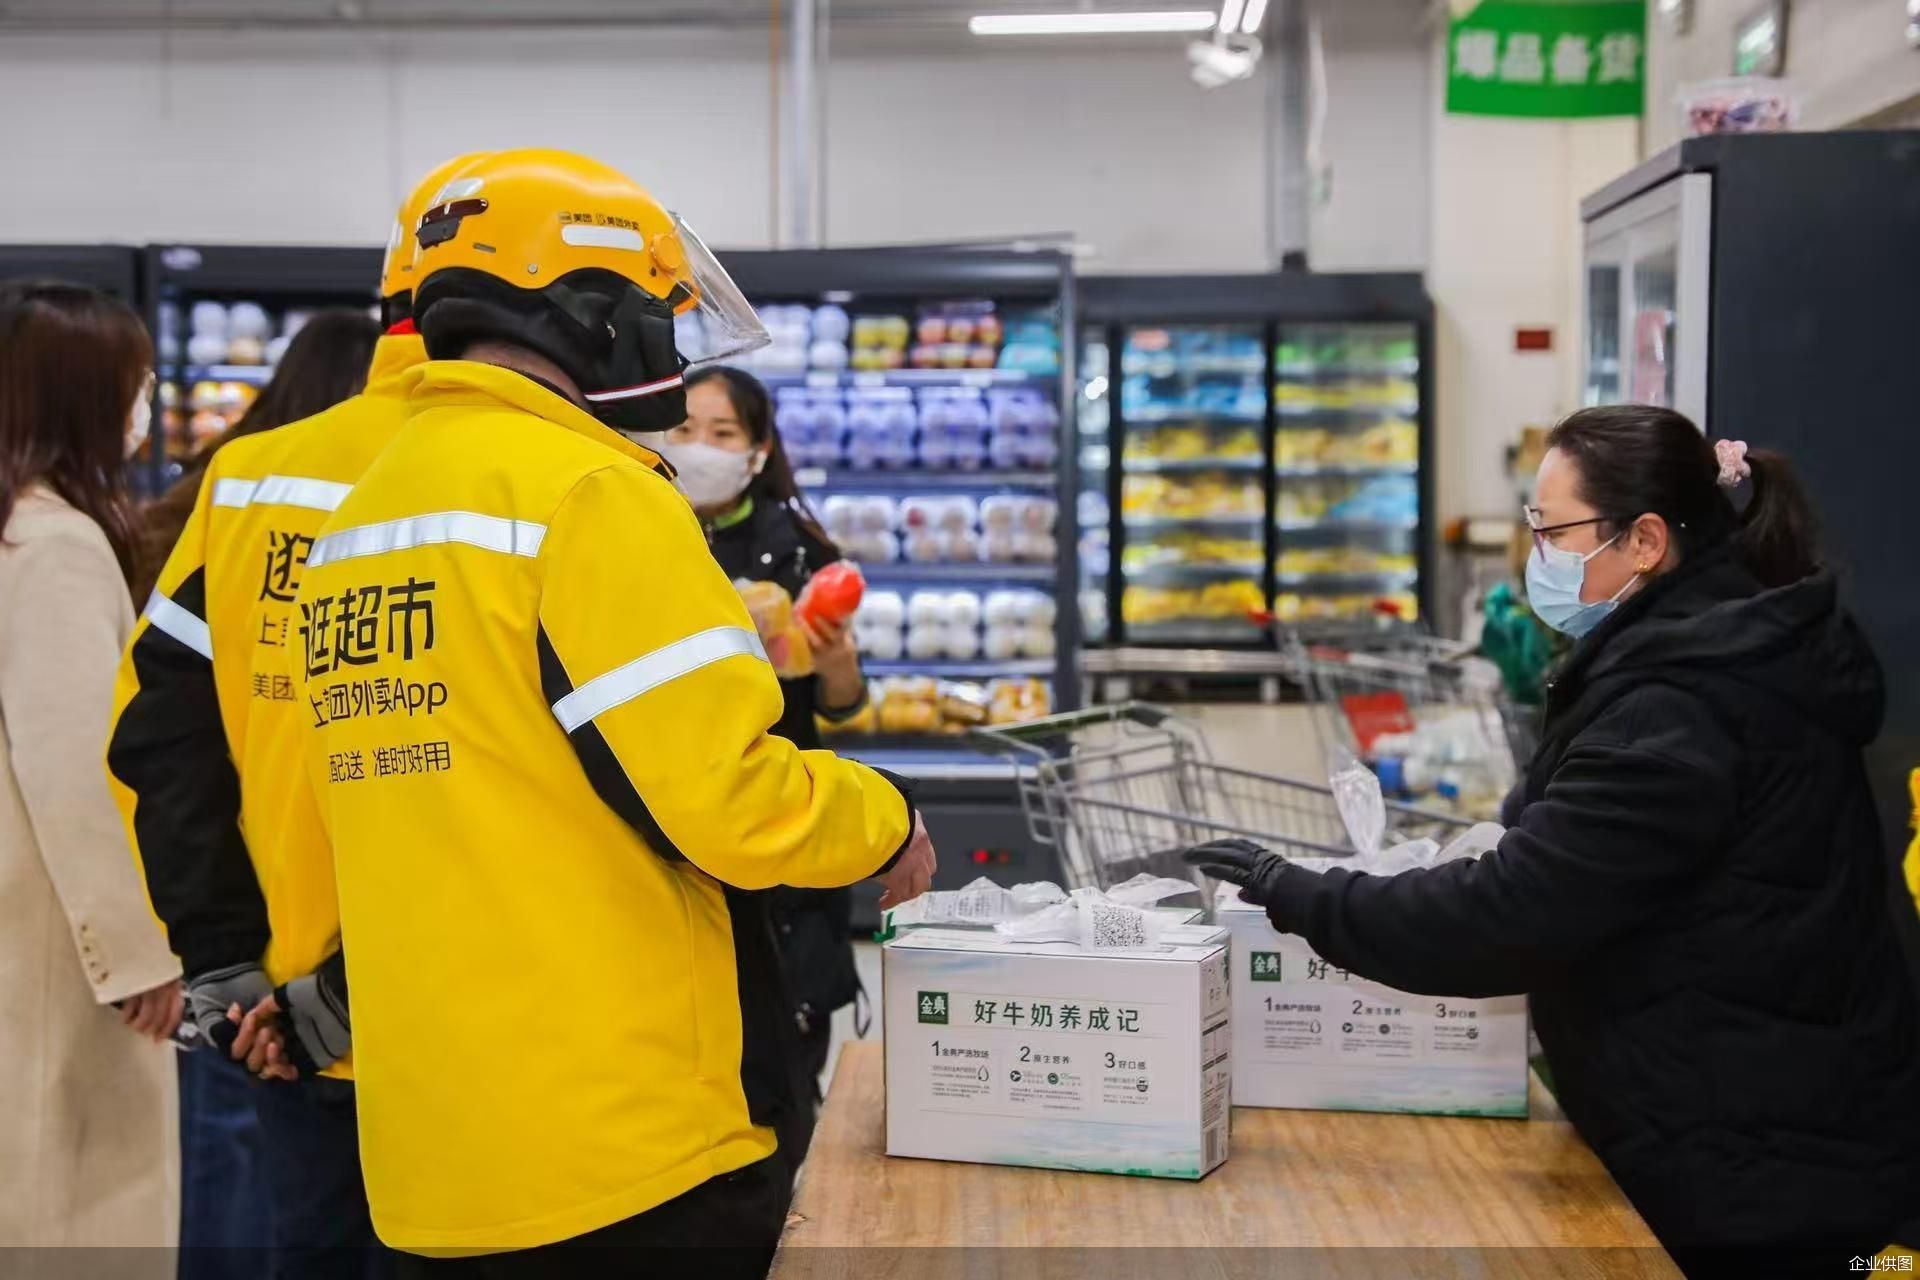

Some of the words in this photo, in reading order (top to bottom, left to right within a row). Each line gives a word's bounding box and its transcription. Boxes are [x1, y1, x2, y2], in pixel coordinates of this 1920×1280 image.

[299, 576, 436, 683] 逛超市
[309, 677, 448, 728] 上团外卖App
[373, 741, 451, 777] 准时好用
[920, 995, 946, 1015] 金典
[974, 999, 1140, 1033] 好牛奶养成记
